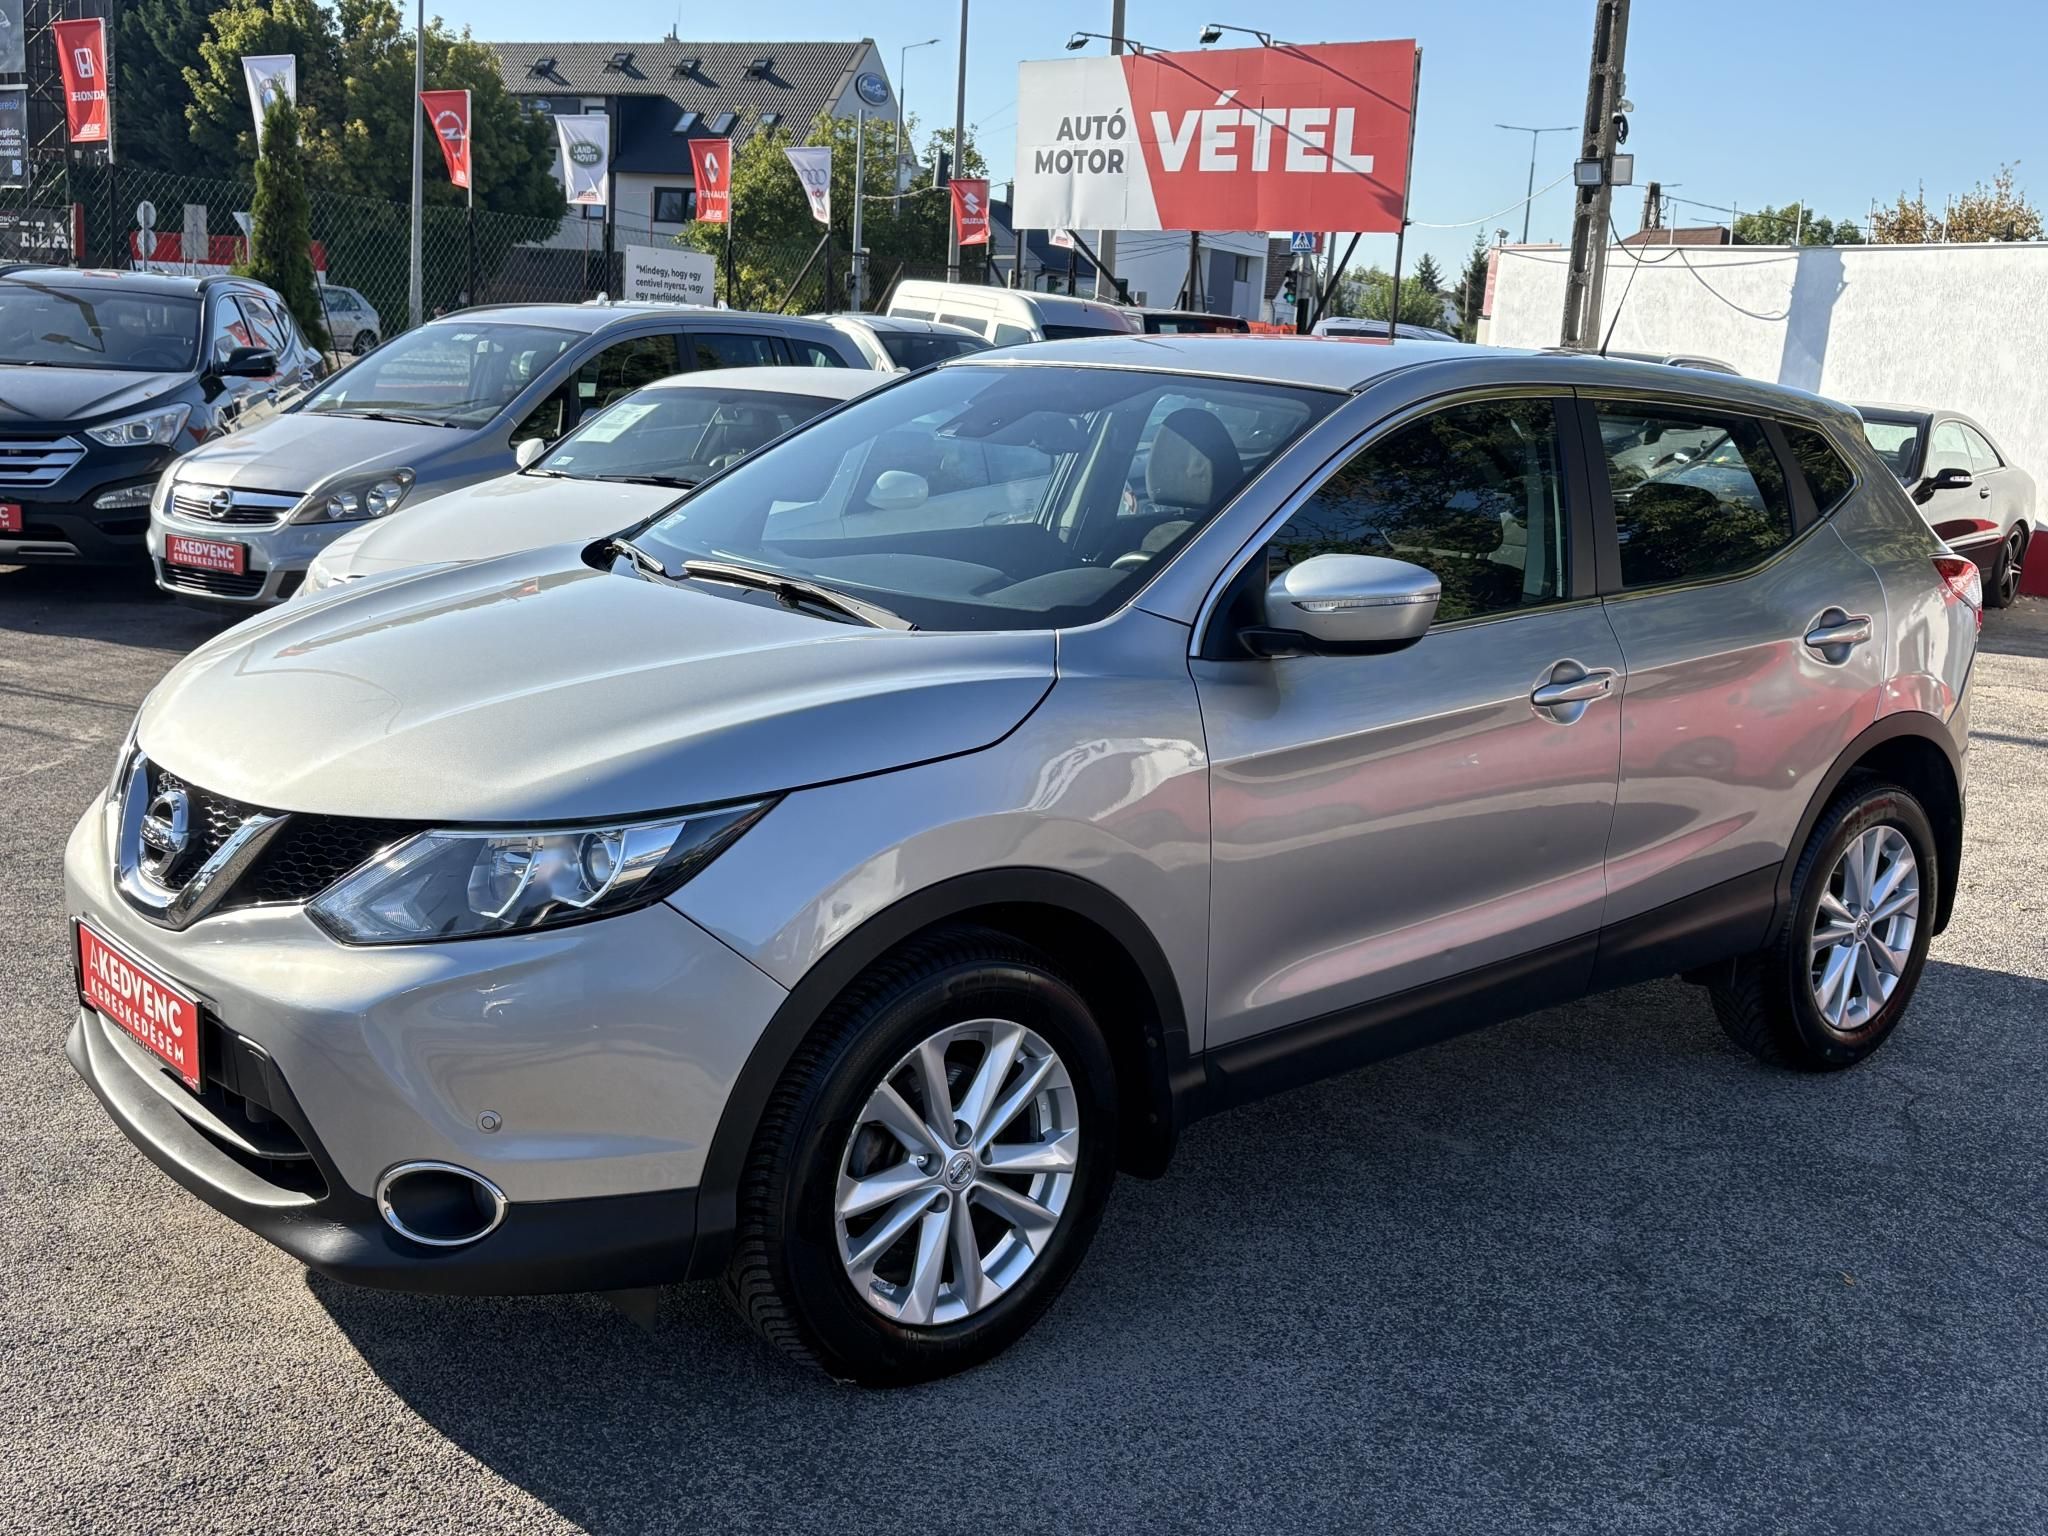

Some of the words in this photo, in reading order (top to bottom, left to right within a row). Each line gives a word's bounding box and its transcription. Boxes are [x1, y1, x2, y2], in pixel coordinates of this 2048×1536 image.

[72, 90, 105, 101] HONDA
[1056, 107, 1126, 141] AUTÓ
[1150, 89, 1375, 174] VÉTEL
[573, 146, 592, 154] LAND
[1035, 148, 1124, 174] MOTOR
[700, 190, 728, 199] RENAULT
[671, 268, 688, 280] hogy
[689, 271, 702, 282] egy
[664, 281, 688, 293] nyersz,
[688, 284, 704, 294] vagy
[636, 291, 649, 301] egy
[173, 552, 235, 569] KERESKEDÉSEM
[90, 975, 185, 1066] KERESKEDÉSEM
